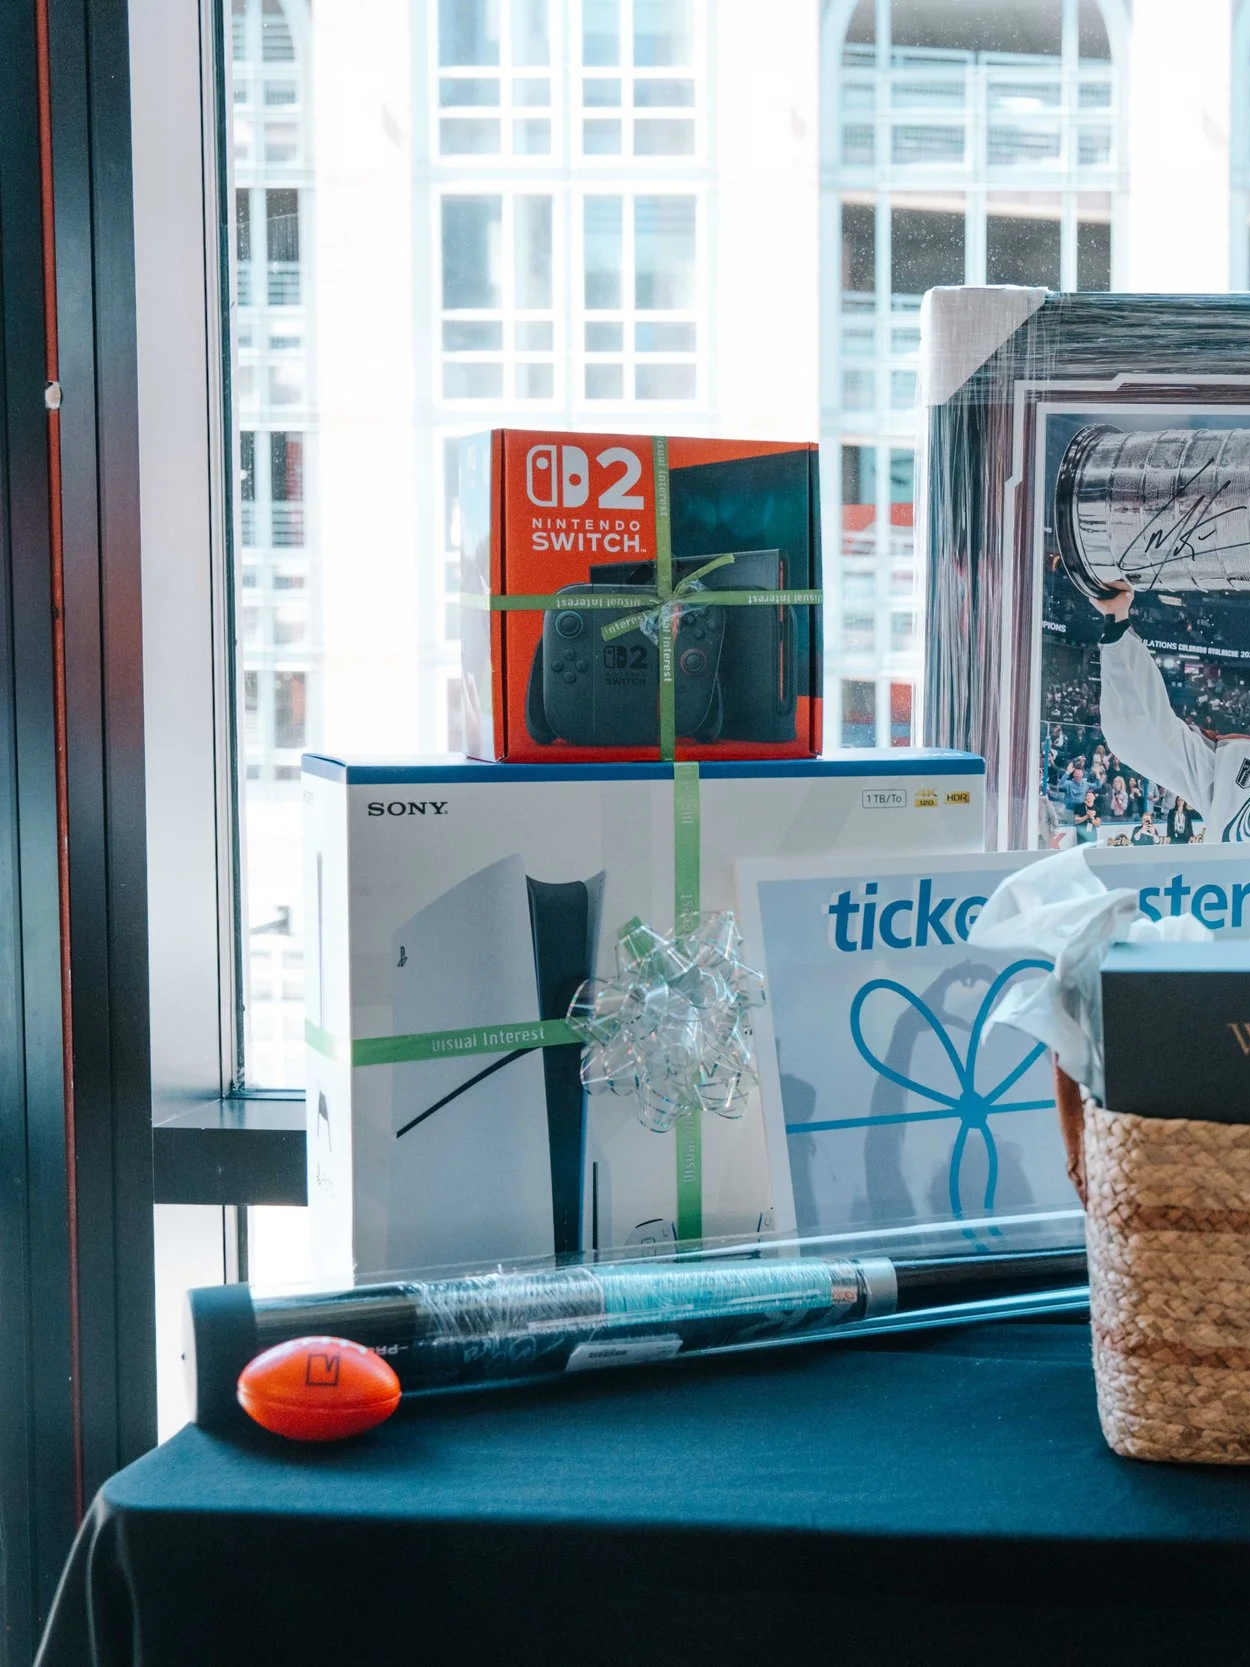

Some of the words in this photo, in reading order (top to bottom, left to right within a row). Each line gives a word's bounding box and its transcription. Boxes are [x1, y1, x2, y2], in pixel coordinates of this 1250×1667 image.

[532, 518, 640, 531] NINTENDO
[532, 531, 640, 553] SWITCH
[557, 598, 602, 608] Interest
[663, 636, 672, 682] Interest
[914, 788, 938, 798] 4K
[946, 793, 968, 802] HDR
[367, 801, 448, 816] SONY
[483, 1026, 546, 1047] Interest
